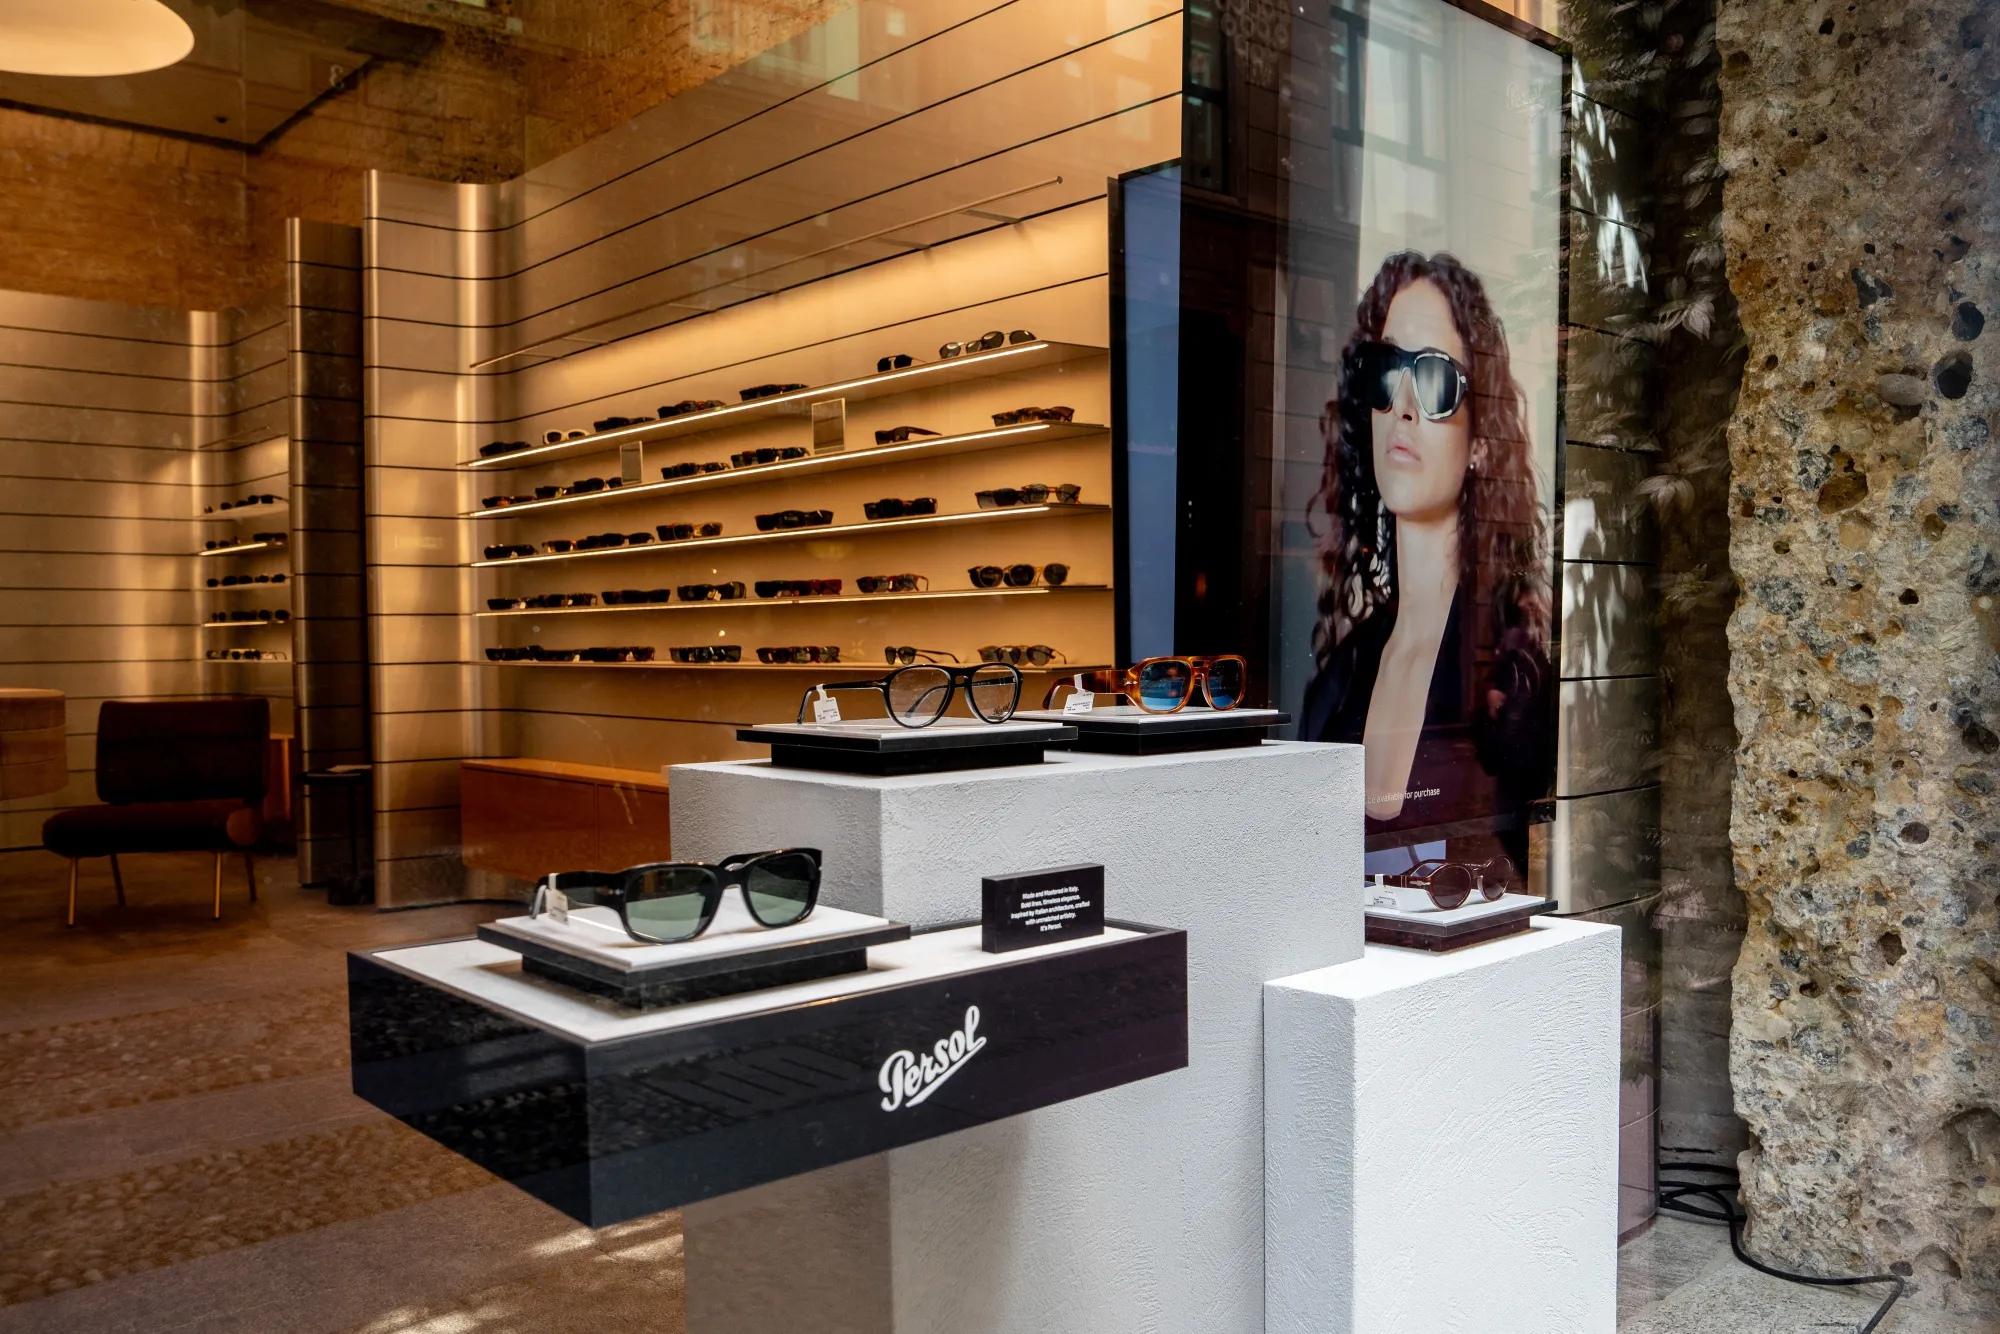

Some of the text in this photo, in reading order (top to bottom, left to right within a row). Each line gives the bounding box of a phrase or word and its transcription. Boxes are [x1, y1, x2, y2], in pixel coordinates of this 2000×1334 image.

[1376, 792, 1403, 803] available
[1404, 790, 1414, 799] for
[1414, 788, 1441, 800] purchase
[1021, 901, 1031, 909] Bold
[1043, 897, 1060, 905] timeless
[1036, 914, 1059, 923] unmatched
[878, 1005, 987, 1112] Persol
